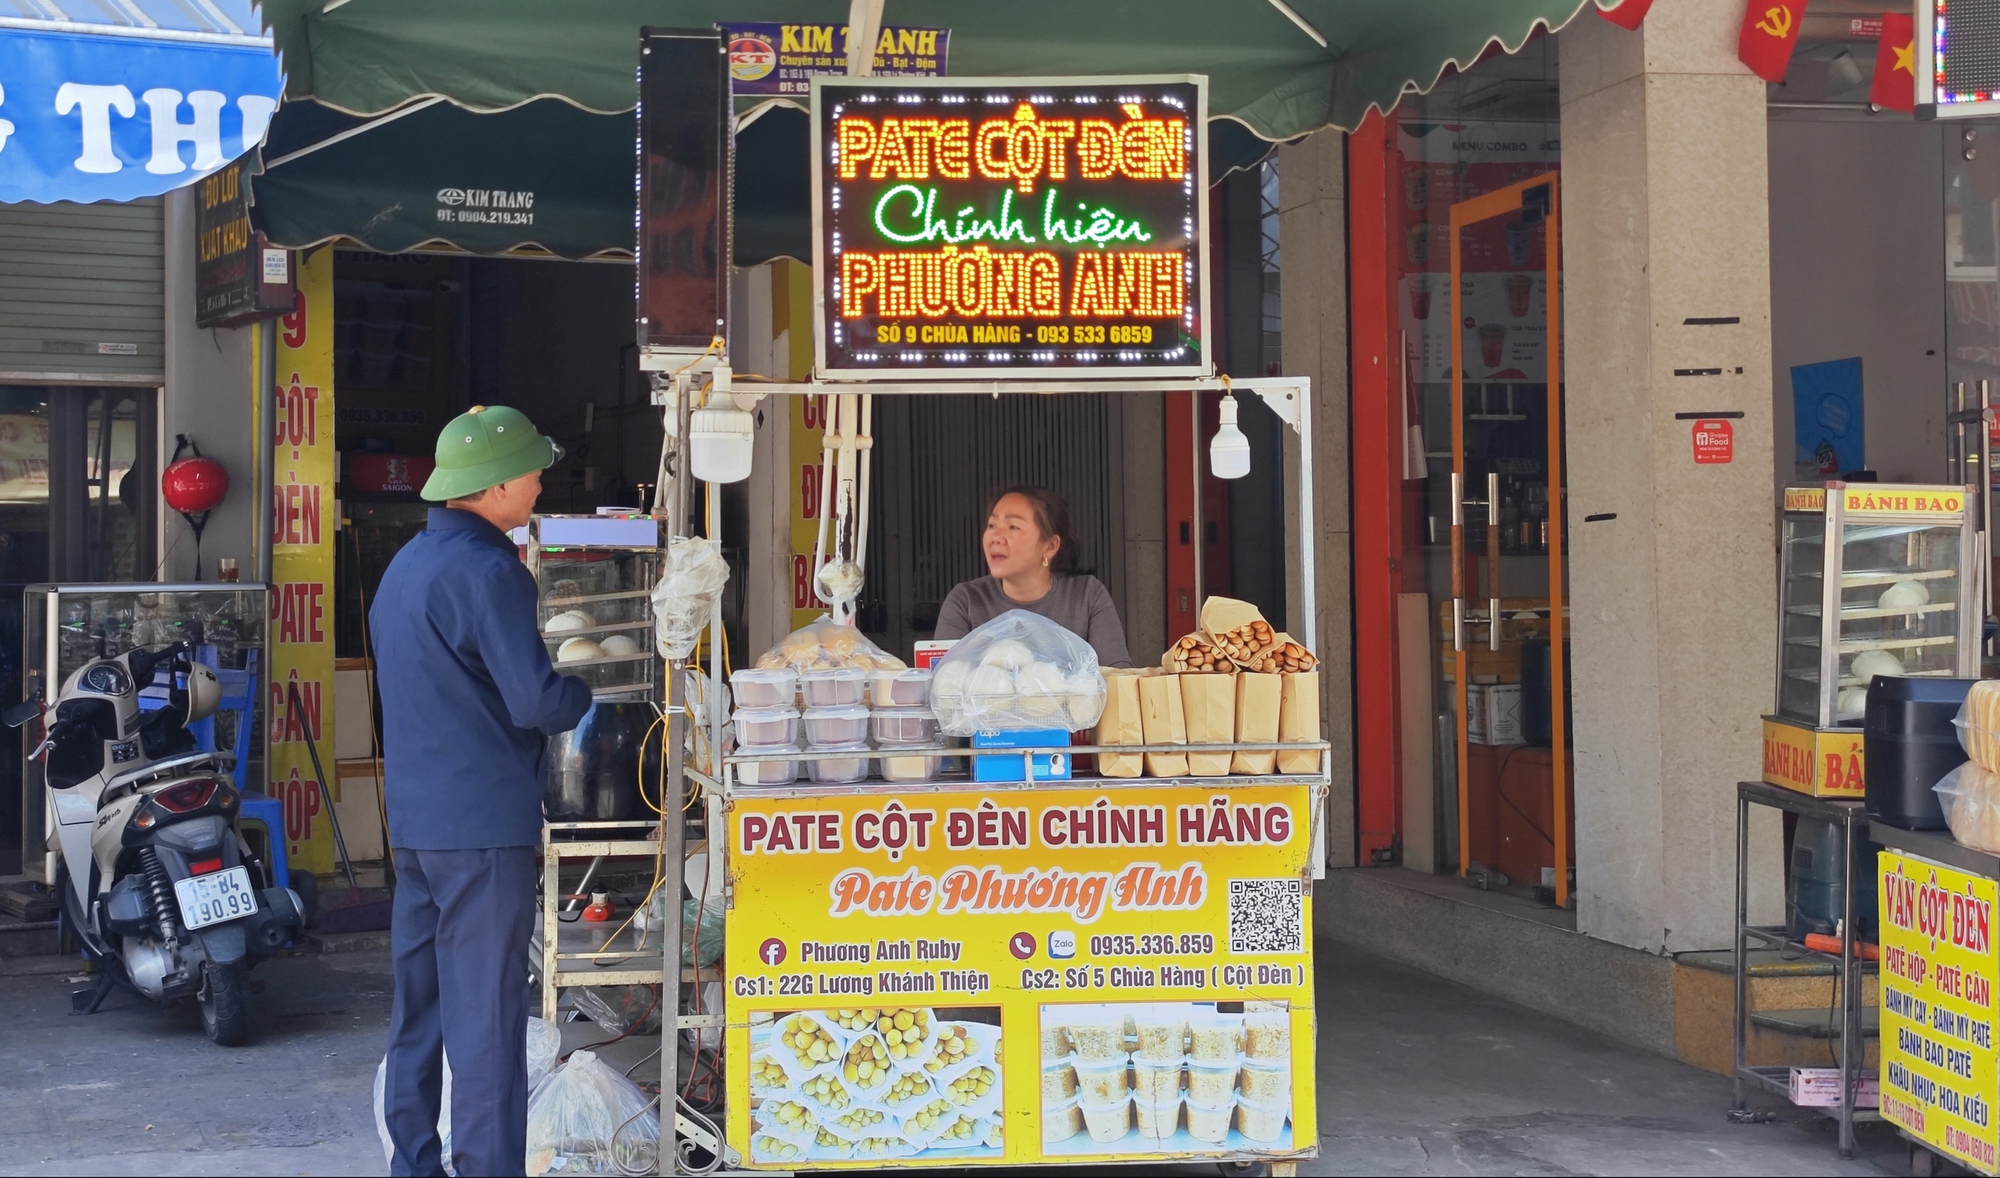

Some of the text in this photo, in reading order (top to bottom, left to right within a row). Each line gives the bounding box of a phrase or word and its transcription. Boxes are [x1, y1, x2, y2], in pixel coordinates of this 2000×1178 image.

[730, 54, 769, 64] KT
[780, 55, 813, 66] Chuyên
[815, 54, 832, 66] sản
[834, 55, 848, 66] xuấ
[893, 57, 908, 70] Bạt
[916, 58, 936, 70] Đệm
[781, 25, 938, 55] KIM ANH
[839, 102, 1185, 194] PATE CỘT ĐÈN
[437, 209, 534, 225] ĐT: 0904.219.341
[466, 189, 534, 209] KIM TRANG
[874, 184, 1152, 249] Chính hiệu
[842, 245, 1185, 317] PHƯƠNG ANH
[282, 288, 307, 348] 9
[877, 321, 900, 343] SỐ
[906, 326, 916, 343] 9
[921, 322, 969, 343] CHÙA
[973, 322, 1020, 343] HÀNG
[1037, 326, 1070, 343] 093
[1074, 326, 1106, 343] 533
[1110, 326, 1152, 343] 6859
[274, 372, 319, 460] CỘT
[273, 471, 320, 545] ĐÈN
[1808, 494, 1824, 508] BAO
[1848, 493, 1959, 511] BÁNH BAO
[272, 583, 324, 643] PATE
[271, 668, 321, 743] CÂN
[1764, 731, 1813, 785] BÁNH BAO
[1825, 742, 1864, 789] BÁ
[744, 799, 1290, 859] PATE CỘT ĐÈN CHÍNH HÃNG
[188, 892, 252, 924] 190.99
[834, 866, 1203, 919] Pate Phương Anh
[1884, 862, 1990, 954] VÂN CỘT ĐÈN
[801, 940, 961, 963] Phương Anh Ruby
[1054, 939, 1074, 948] Zalo
[1090, 934, 1213, 955] 0935.336.859
[734, 970, 989, 996] Cs1: 22G Lương Khánh Thiện
[1022, 969, 1060, 989] Cs2:
[1065, 965, 1089, 988] Số
[1094, 969, 1104, 987] 5
[1110, 967, 1154, 987] Chùa
[1160, 966, 1205, 988] Hàng
[1223, 966, 1253, 989] Cột
[1257, 964, 1292, 985] Đèn
[1886, 946, 1905, 977] PATÊ
[1907, 951, 1926, 988] HỘP
[1936, 964, 1961, 998] PATÊ
[1965, 971, 1990, 1008] CÂN
[1886, 985, 1901, 1014] BÁNH
[1903, 991, 1912, 1018] MỲ
[1915, 1000, 1927, 1025] CAY
[1933, 1004, 1954, 1035] BÁNH
[1957, 1013, 1968, 1040] MỲ
[1971, 1020, 1991, 1049] PATÊ
[1899, 1027, 1971, 1079] BÁNH BAO PATÊ
[1888, 1061, 1909, 1092] KHÂU
[1912, 1074, 1935, 1107] NHỤC
[1939, 1085, 1959, 1115] HOA
